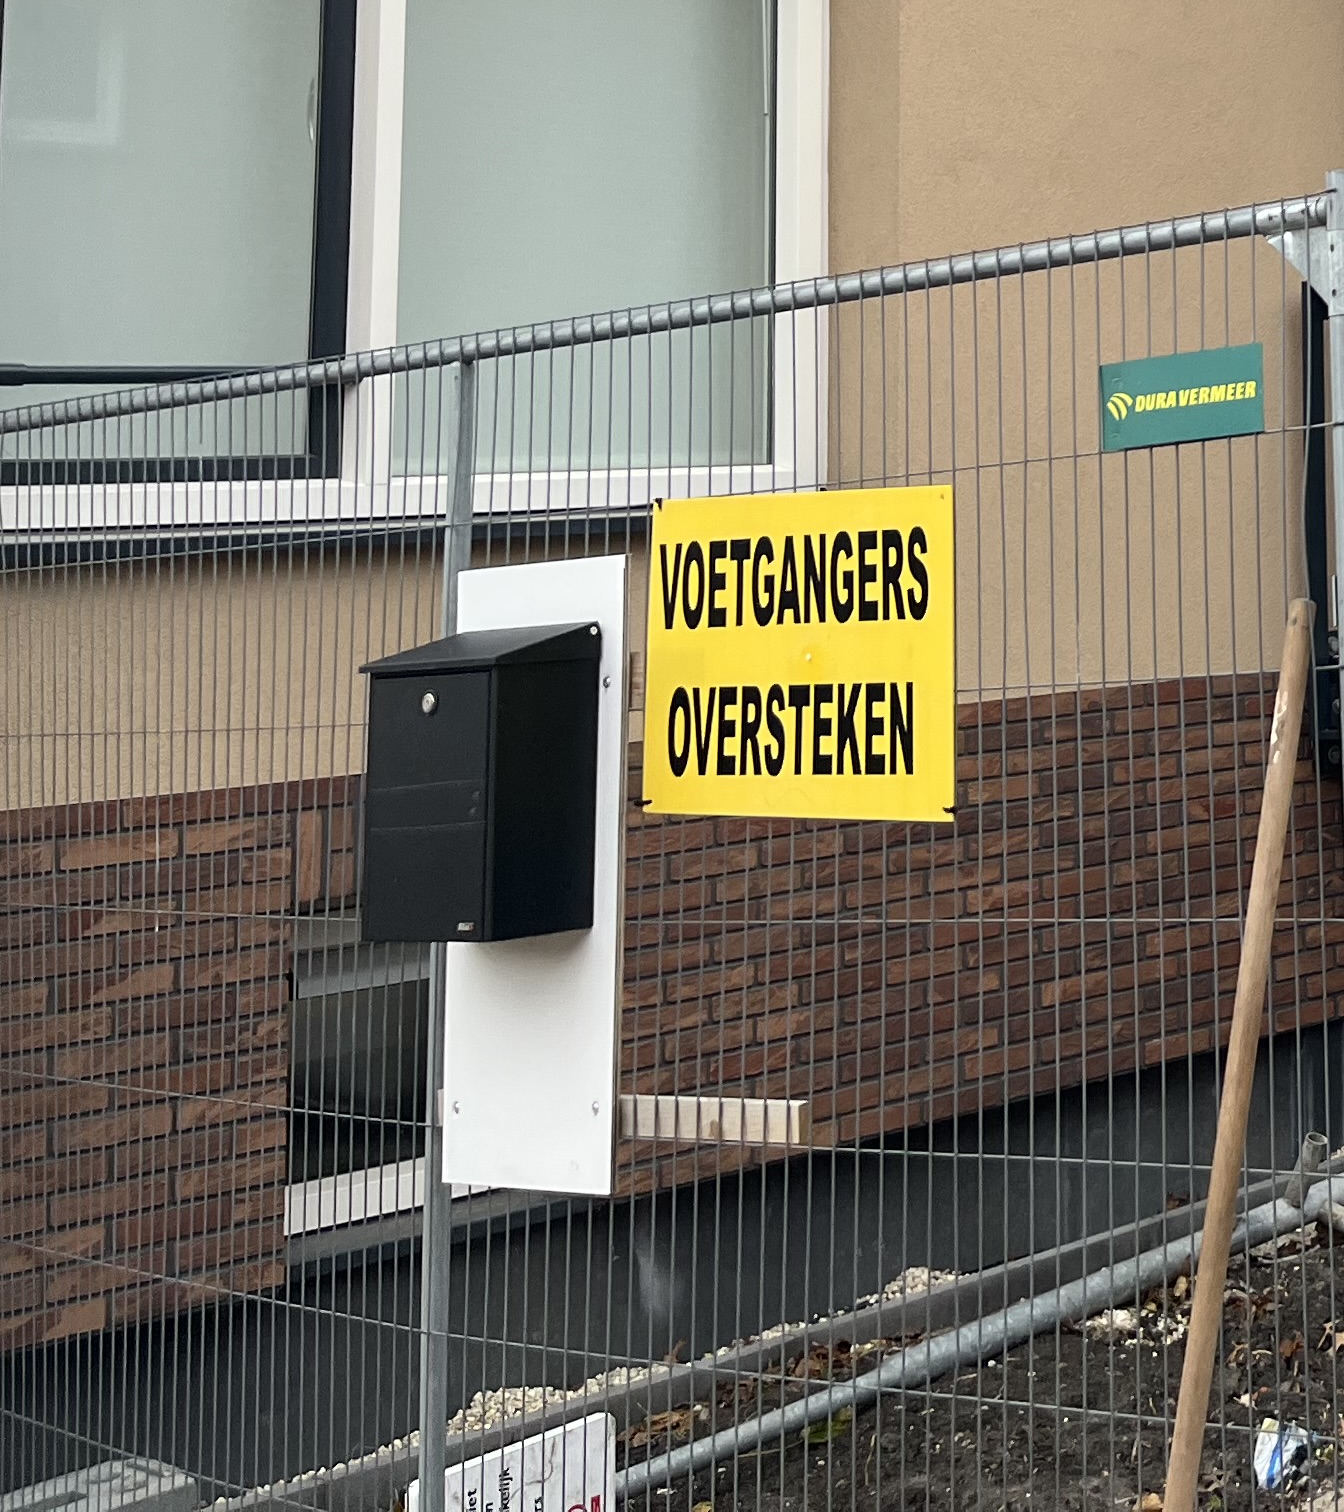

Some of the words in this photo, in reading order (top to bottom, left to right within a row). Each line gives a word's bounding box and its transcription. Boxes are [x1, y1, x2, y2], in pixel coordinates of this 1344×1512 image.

[1135, 391, 1177, 413] DURA
[1178, 380, 1257, 407] VERMEER
[659, 526, 929, 630] VOETGANGERS
[668, 682, 914, 777] OVERSTEKEN
